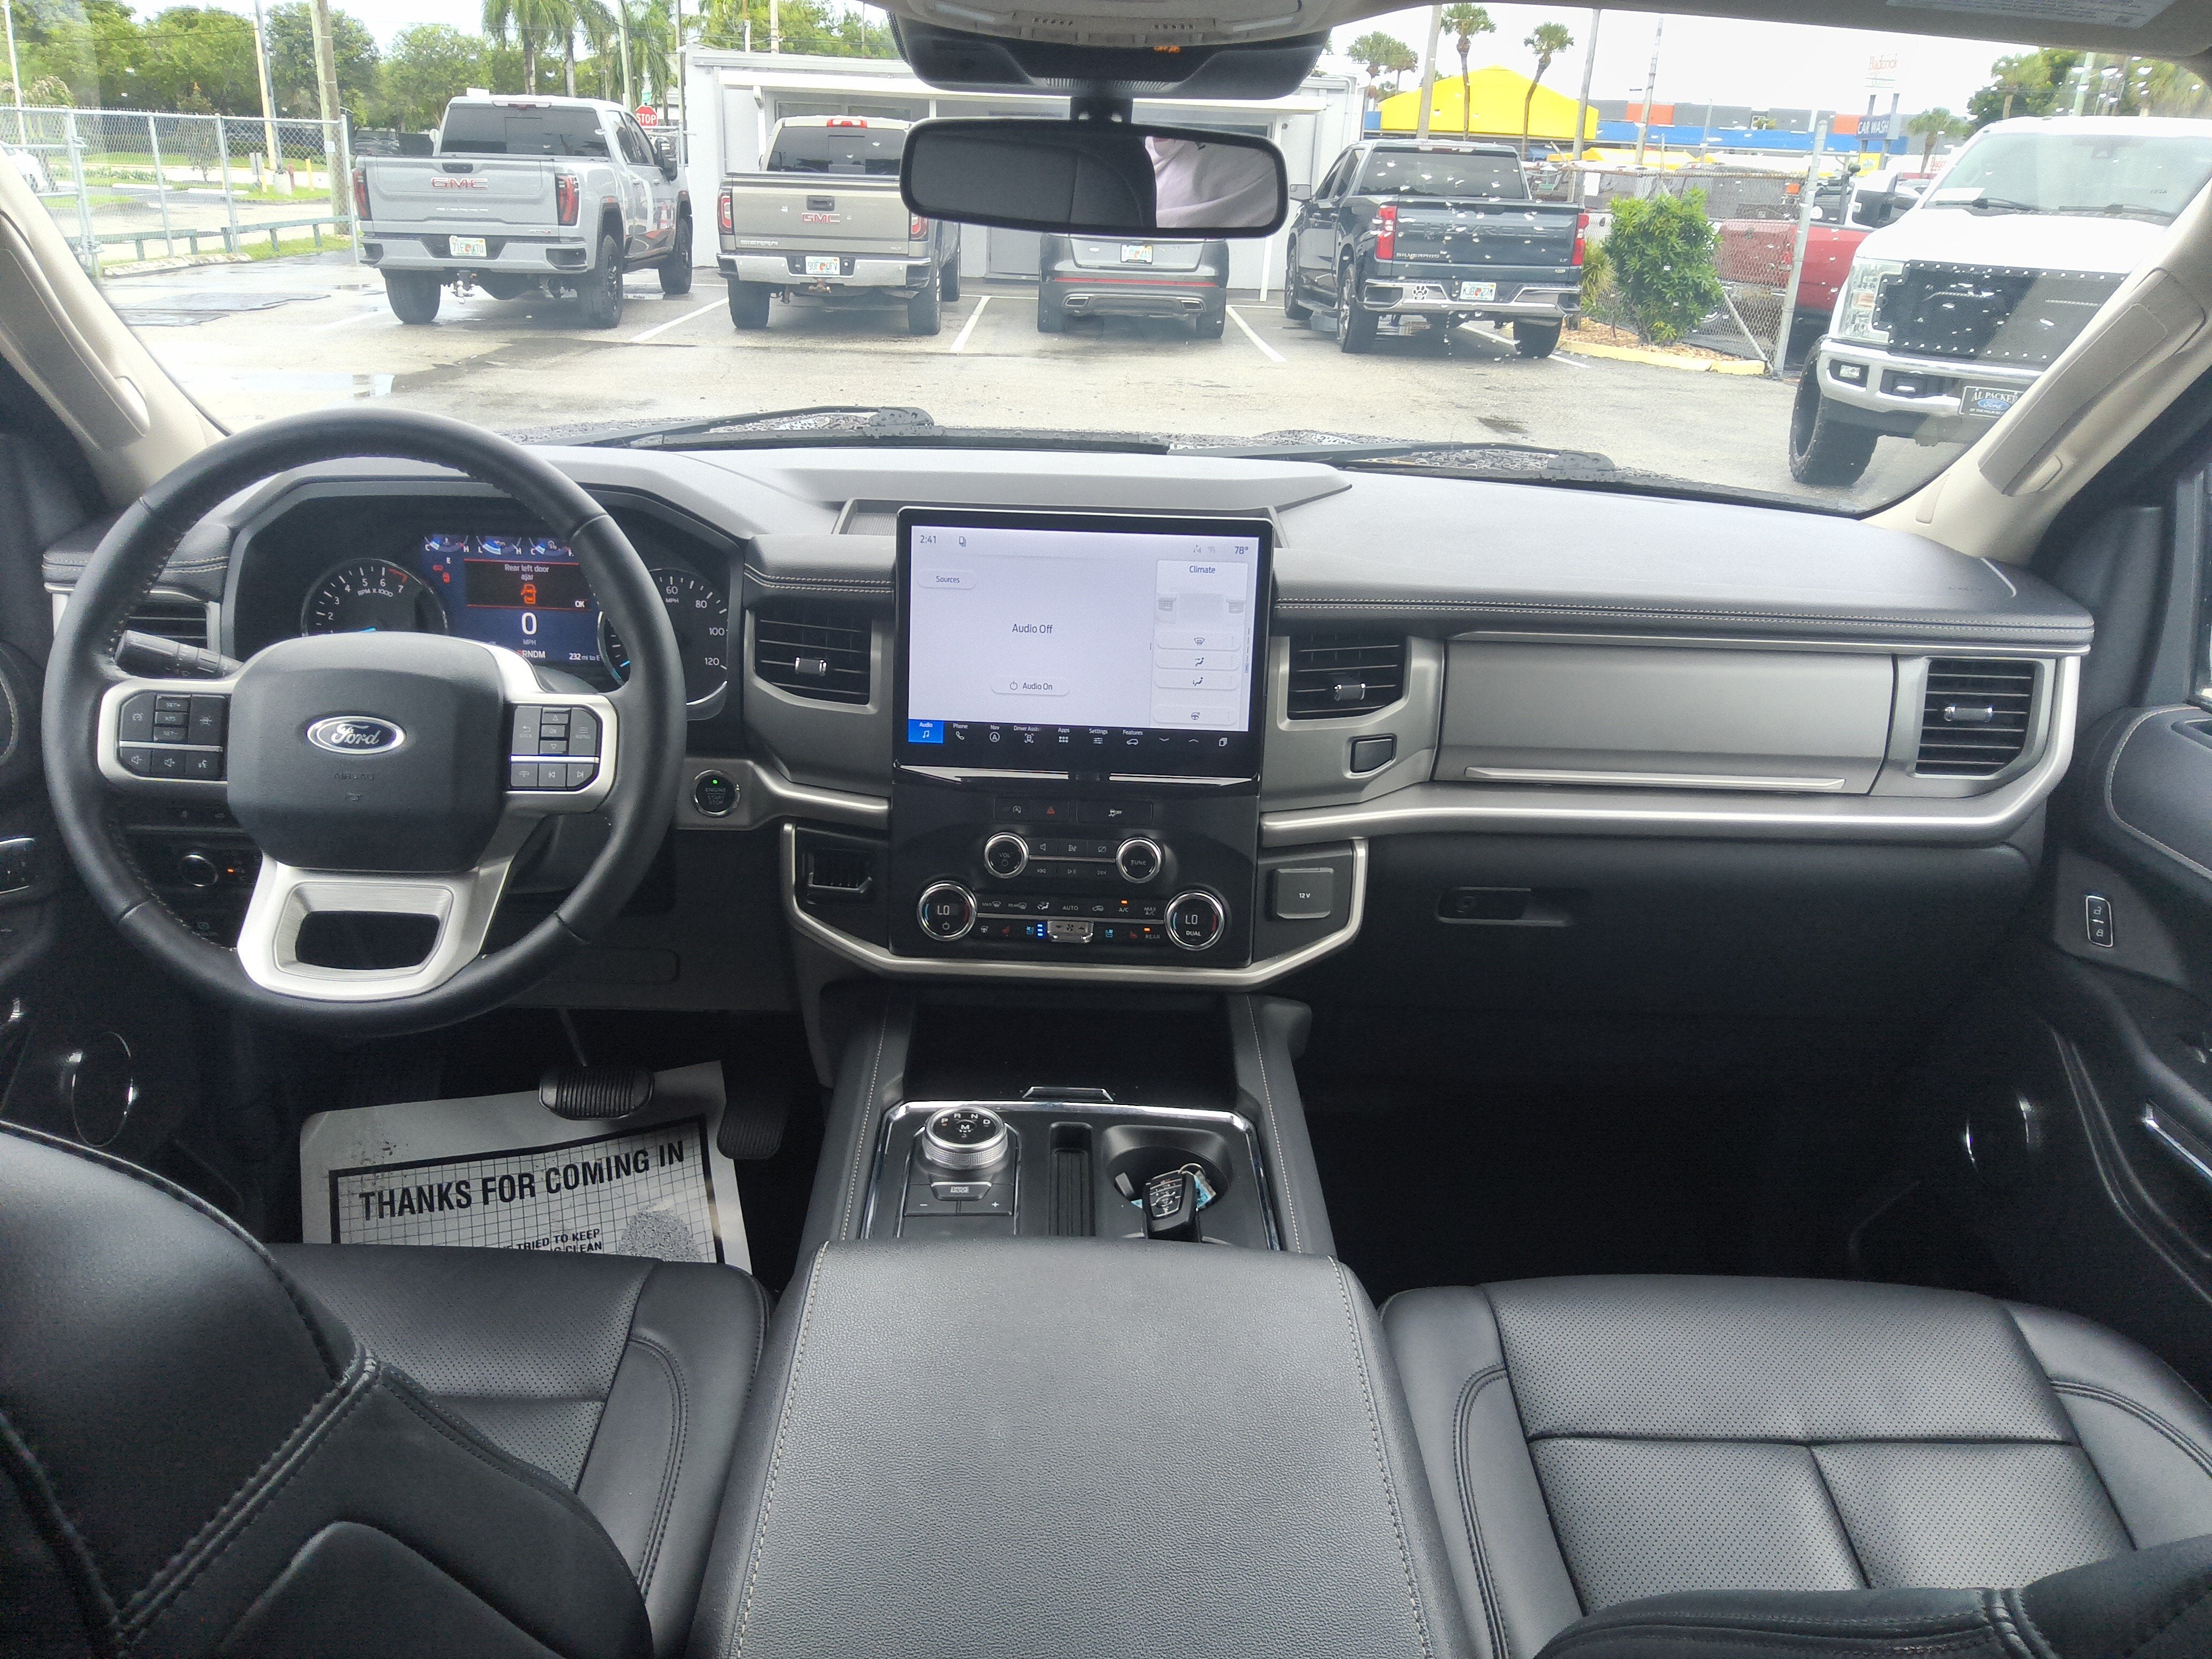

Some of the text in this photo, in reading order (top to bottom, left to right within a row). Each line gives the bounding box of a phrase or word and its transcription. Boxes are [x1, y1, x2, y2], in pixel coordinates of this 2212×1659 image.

[1869, 53, 1899, 71] Badcock
[636, 113, 656, 124] STOP
[1857, 121, 1890, 134] CAR WASH
[431, 177, 488, 189] GMC
[802, 212, 840, 223] GMC
[1970, 391, 1983, 402] AL
[920, 535, 937, 544] 2:41
[504, 564, 549, 573] Rear left door
[1189, 565, 1216, 574] Climate
[521, 573, 534, 581] ajar
[936, 576, 960, 584] Sources
[362, 578, 368, 587] 5
[380, 578, 386, 587] 6
[345, 584, 352, 593] 4
[378, 588, 393, 597] 1000
[398, 585, 404, 593] 7
[666, 586, 678, 594] 60
[334, 596, 340, 605] 3
[695, 600, 707, 608] 80
[327, 612, 334, 621] 2
[521, 612, 537, 635] 0
[709, 627, 725, 636] 100
[1012, 623, 1053, 634] Audio Off
[569, 653, 581, 661] 232
[704, 657, 720, 666] 120
[331, 723, 380, 745] Ford
[937, 905, 950, 915] LO
[1185, 914, 1198, 925] LO
[358, 1140, 685, 1221] THANKS FOR COMING IN
[517, 1237, 550, 1250] TRIED
[552, 1234, 569, 1244] TO
[572, 1228, 600, 1242] KEEP
[565, 1240, 603, 1253] CLEAN
